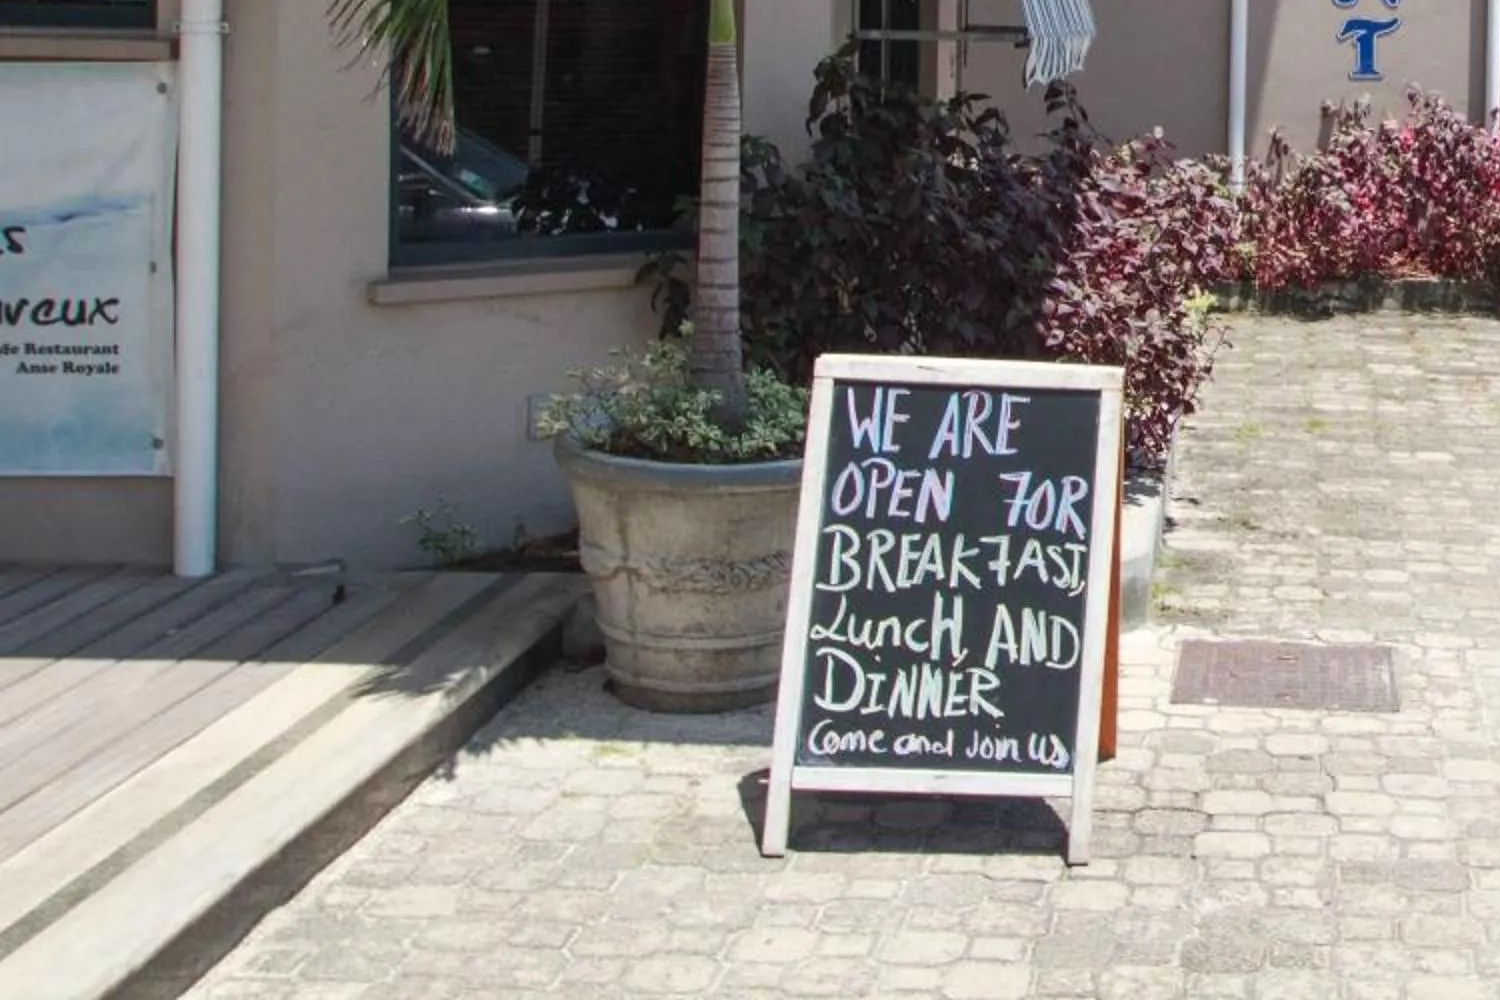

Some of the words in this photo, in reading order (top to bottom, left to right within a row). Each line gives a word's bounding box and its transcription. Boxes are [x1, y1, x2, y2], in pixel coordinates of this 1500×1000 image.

[16, 361, 58, 374] Anse
[62, 361, 119, 376] Royale
[24, 343, 119, 355] Restaurant
[846, 386, 912, 454] WE
[928, 390, 1030, 459] ARE
[831, 457, 955, 523] OPEN
[984, 603, 1081, 670] AND
[808, 719, 888, 755] Come
[892, 730, 954, 758] and
